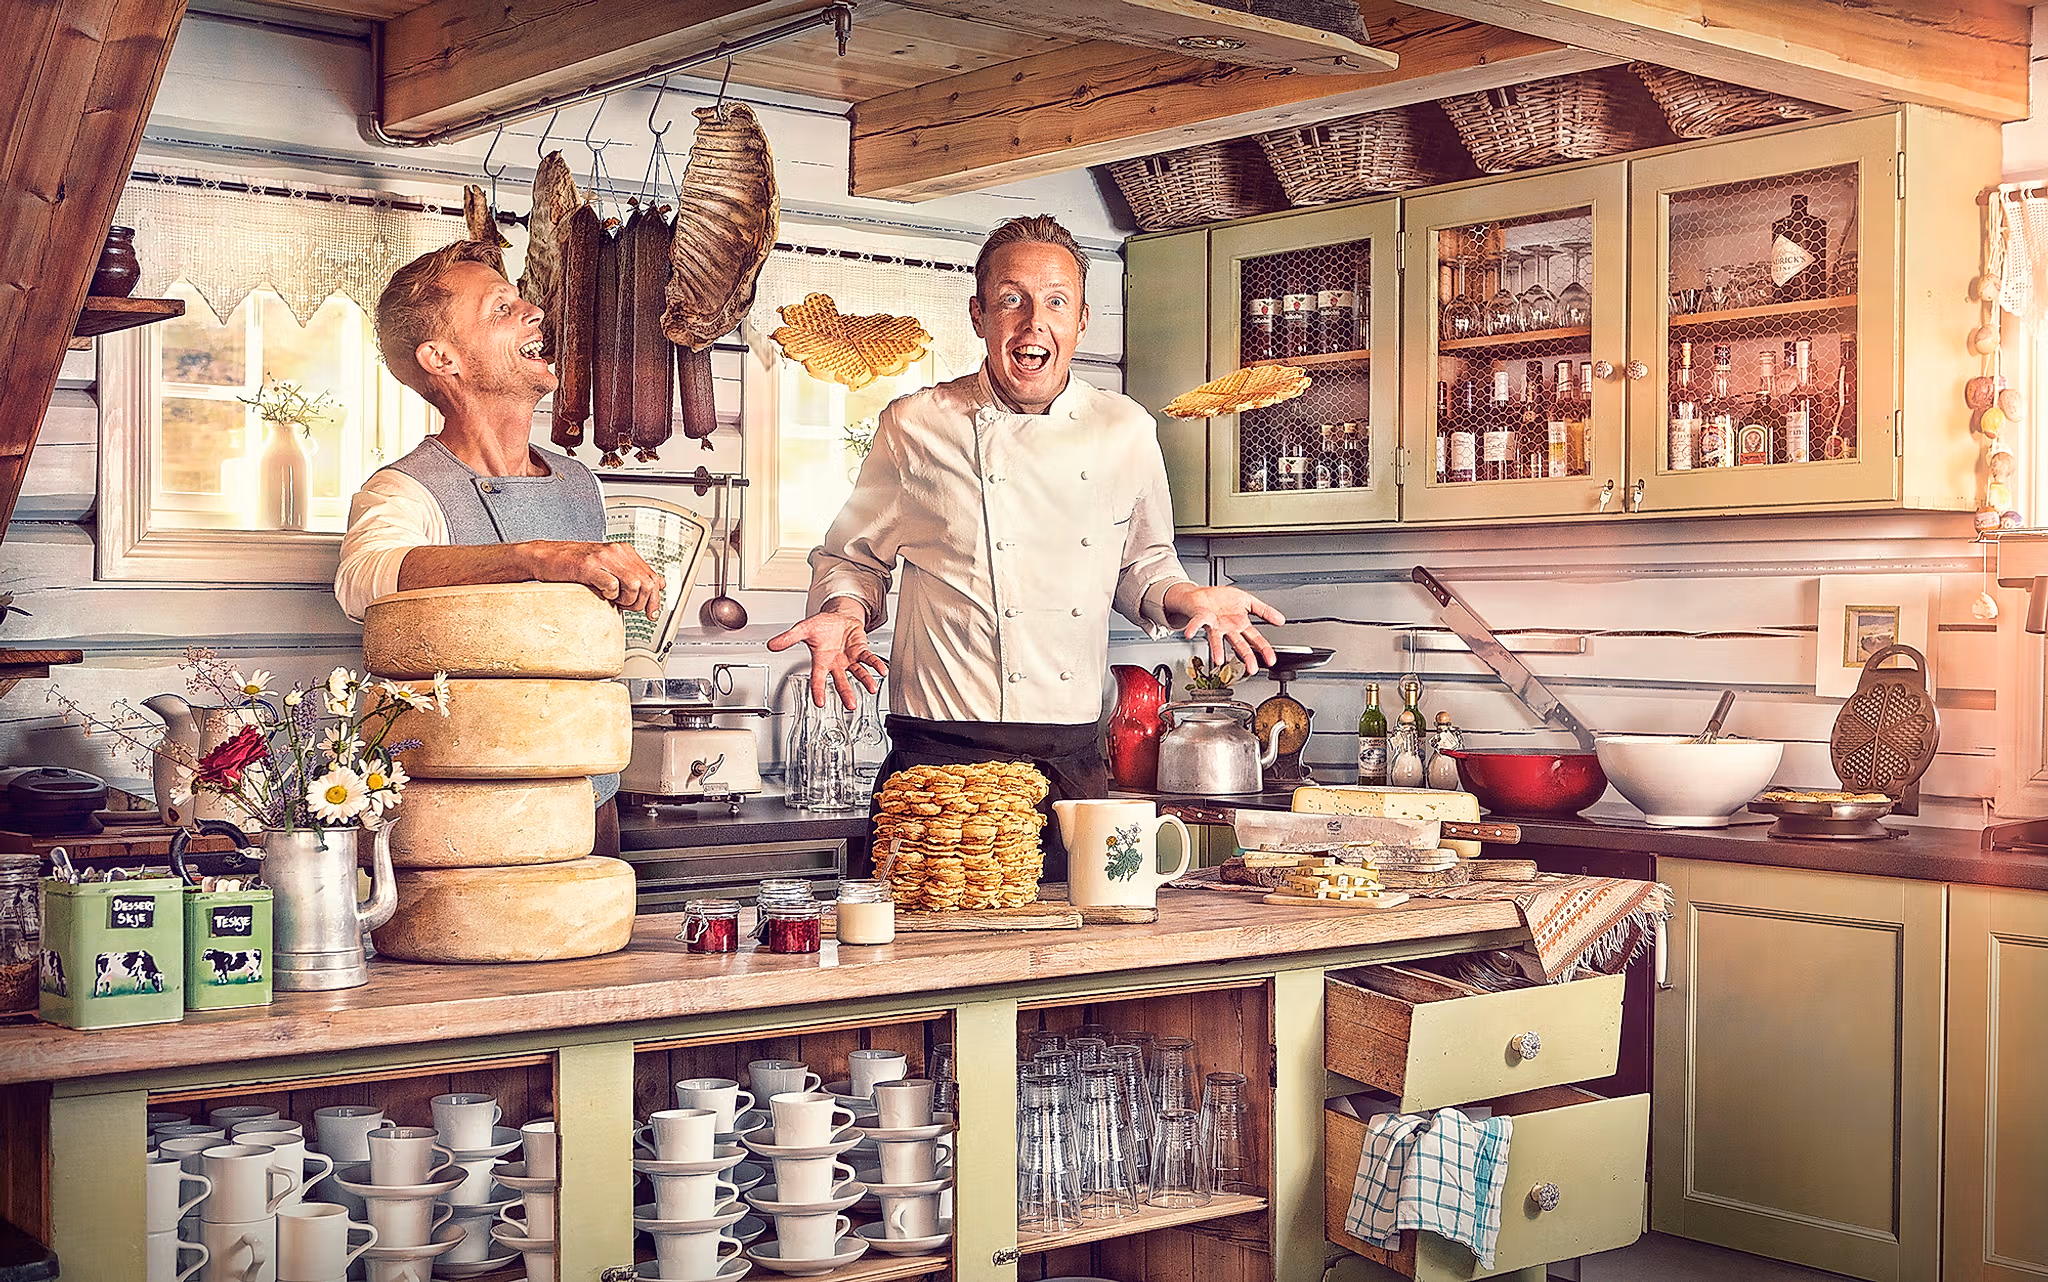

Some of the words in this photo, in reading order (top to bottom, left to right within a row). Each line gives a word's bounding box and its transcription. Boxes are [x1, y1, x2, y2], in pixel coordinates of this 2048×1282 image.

[113, 899, 155, 911] DESSERT
[117, 912, 146, 928] SKJE
[213, 915, 252, 932] TESKJE
